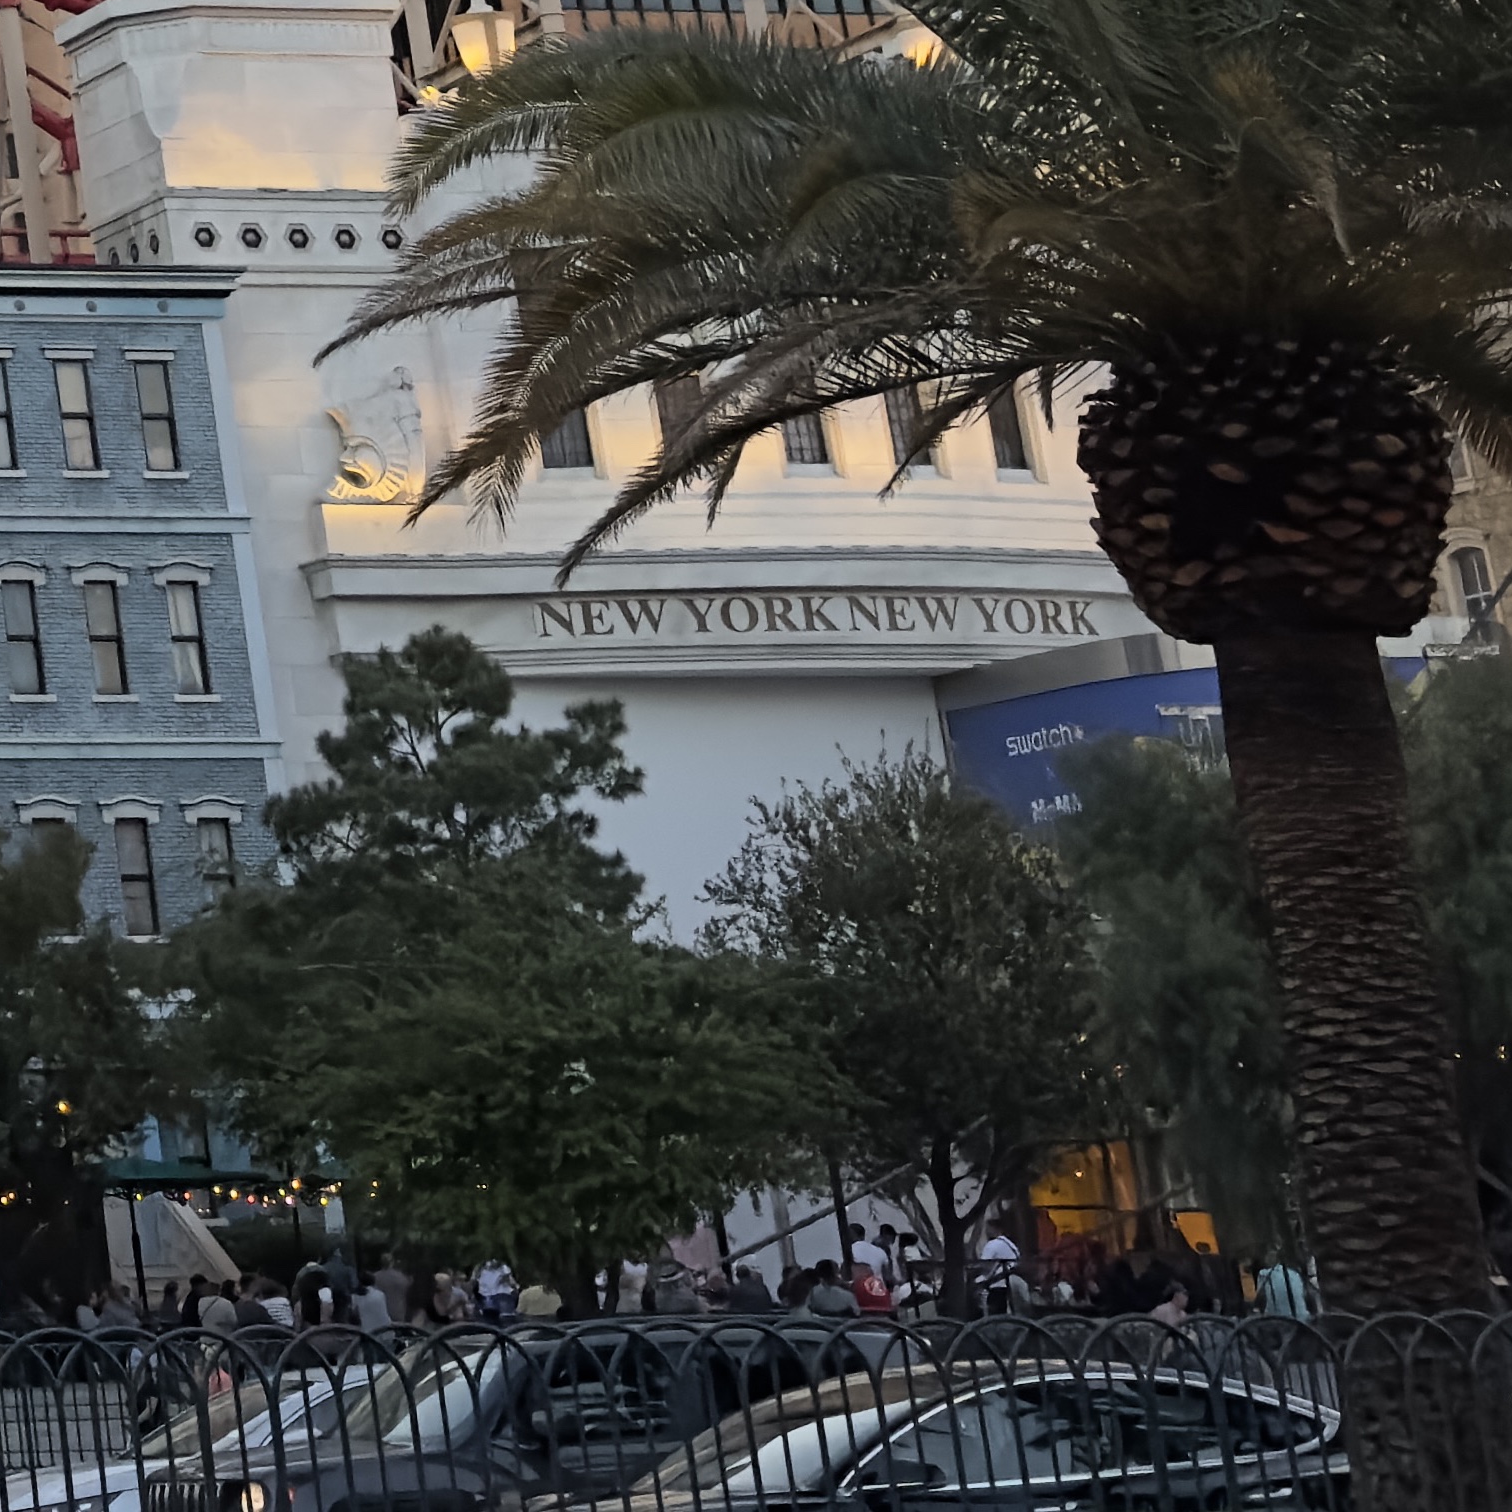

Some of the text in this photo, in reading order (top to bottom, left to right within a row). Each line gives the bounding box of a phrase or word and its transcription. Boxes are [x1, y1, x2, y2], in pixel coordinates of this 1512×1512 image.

[534, 594, 1100, 638] NEW YORK NEW YORK
[1005, 723, 1074, 757] swatch
